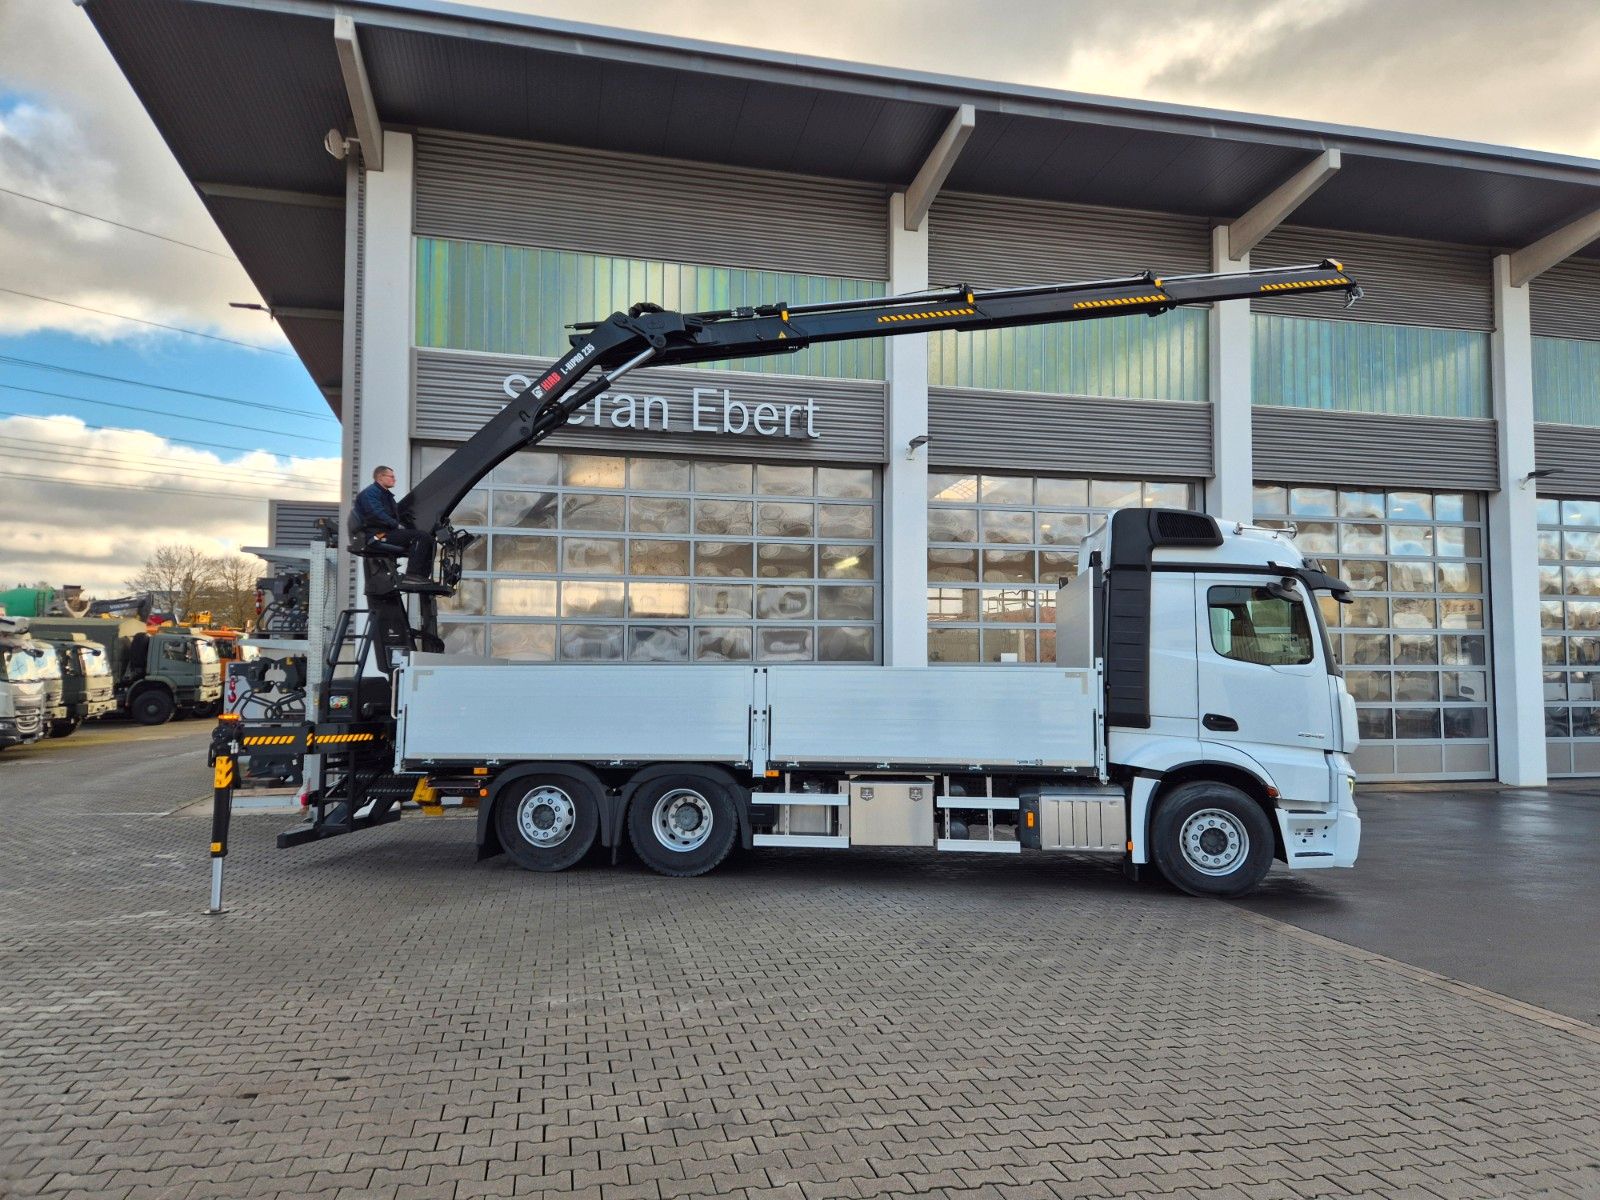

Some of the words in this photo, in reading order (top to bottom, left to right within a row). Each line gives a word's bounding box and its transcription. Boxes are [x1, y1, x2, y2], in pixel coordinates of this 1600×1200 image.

[539, 371, 562, 392] HIAB
[560, 352, 585, 375] L-HIPRO
[581, 342, 596, 357] 235
[692, 387, 821, 438] Ebert
